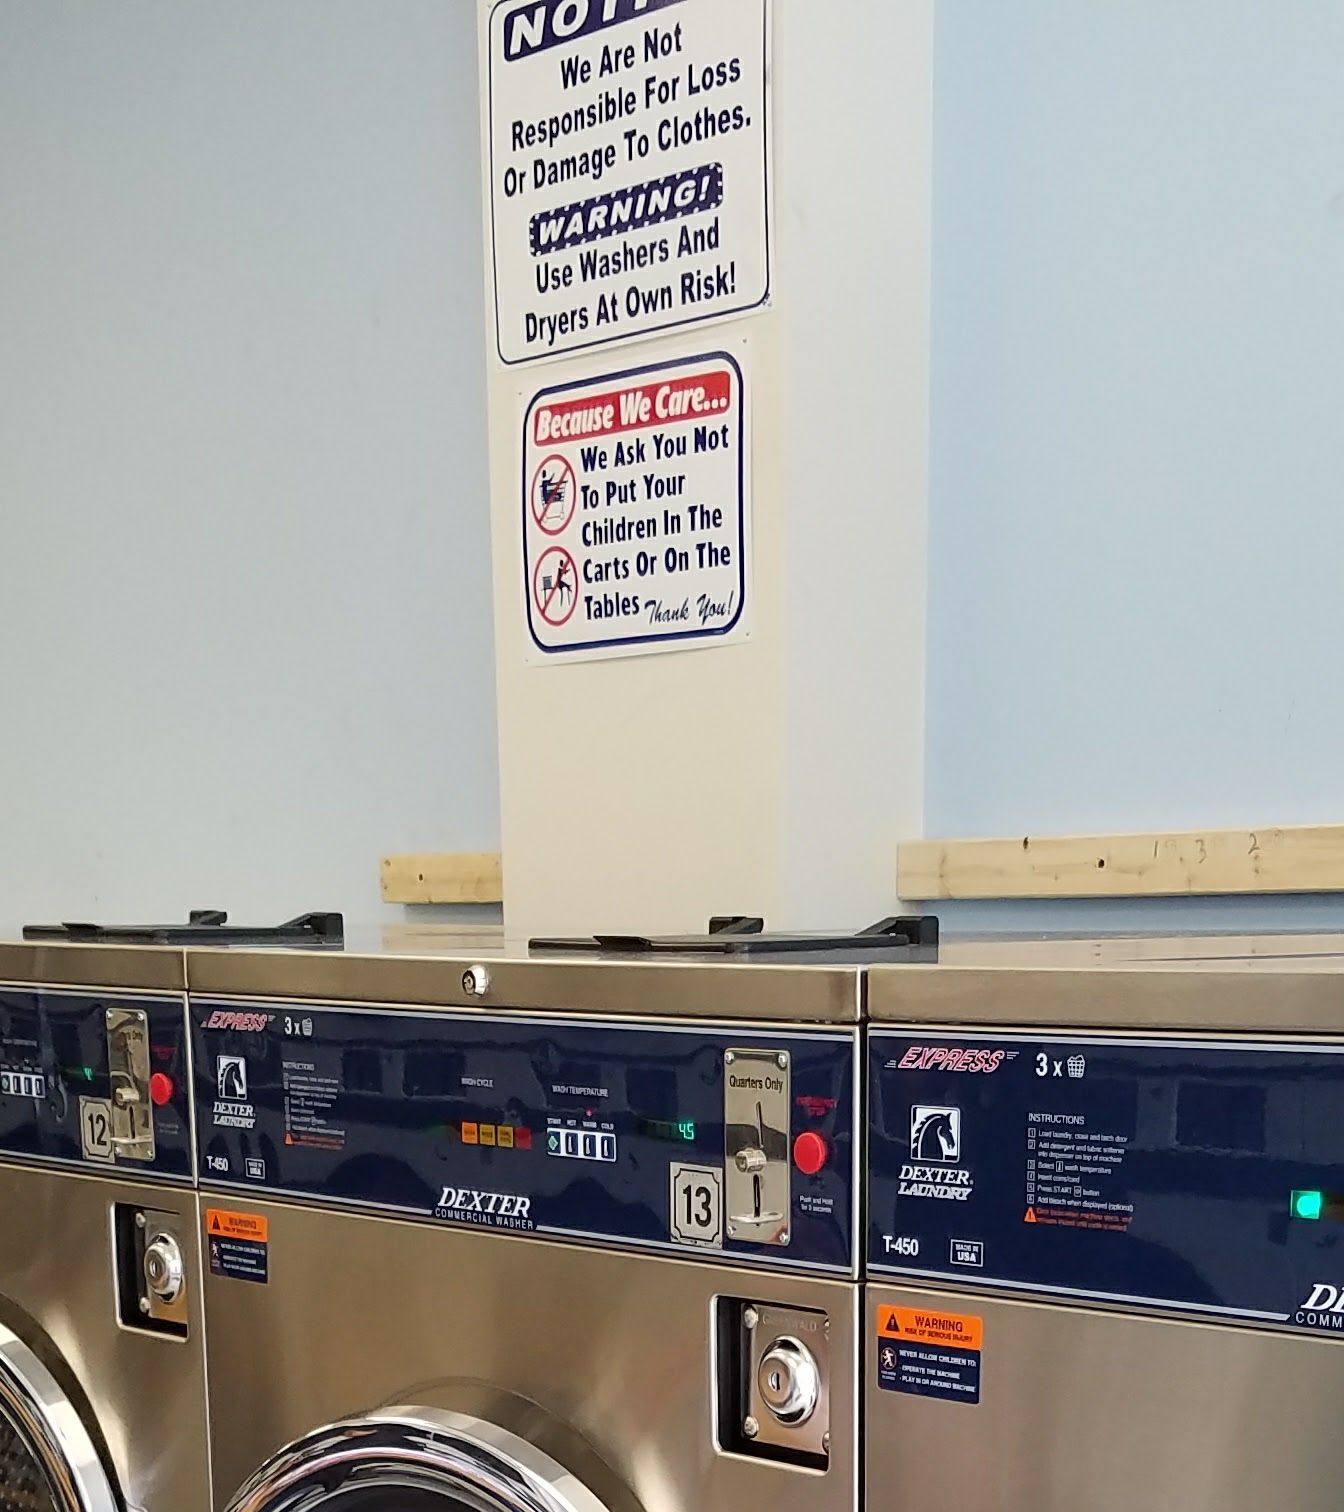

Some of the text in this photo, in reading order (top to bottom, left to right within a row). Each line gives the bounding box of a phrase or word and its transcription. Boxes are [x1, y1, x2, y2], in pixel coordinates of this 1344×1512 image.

[561, 23, 682, 90] We Are Not
[512, 57, 742, 152] Responsible For Loss
[504, 105, 751, 198] Or Damage To Clothes.
[539, 176, 711, 245] WARNING!
[535, 217, 720, 294] Use Washers And
[525, 261, 736, 347] Dryers At Own Risk!
[536, 386, 727, 442] Because We Care...
[580, 424, 729, 472] We Ask You Not
[581, 474, 686, 510] To Put Your
[582, 504, 722, 547] Children In The
[582, 542, 731, 584] Carts Or On The
[584, 590, 734, 626] Tables Thank You!
[207, 1011, 292, 1036] EXPRESS 3
[898, 1045, 1049, 1078] EXPRESS 3
[730, 1075, 783, 1094] Quarters Only
[213, 1102, 253, 1117] DEXTER
[1028, 1112, 1085, 1125] INSTRUCTIONS
[88, 1113, 107, 1147] 12
[678, 1123, 694, 1140] 45
[206, 1156, 228, 1171] T-450
[437, 1187, 531, 1218] DEXTER
[682, 1185, 713, 1228] 13
[897, 1182, 972, 1201] LAUNDRY
[435, 1208, 493, 1224] COMMERCIAL
[882, 1235, 919, 1256] T-450
[957, 1251, 976, 1263] USA
[914, 1315, 963, 1332] WARNING
